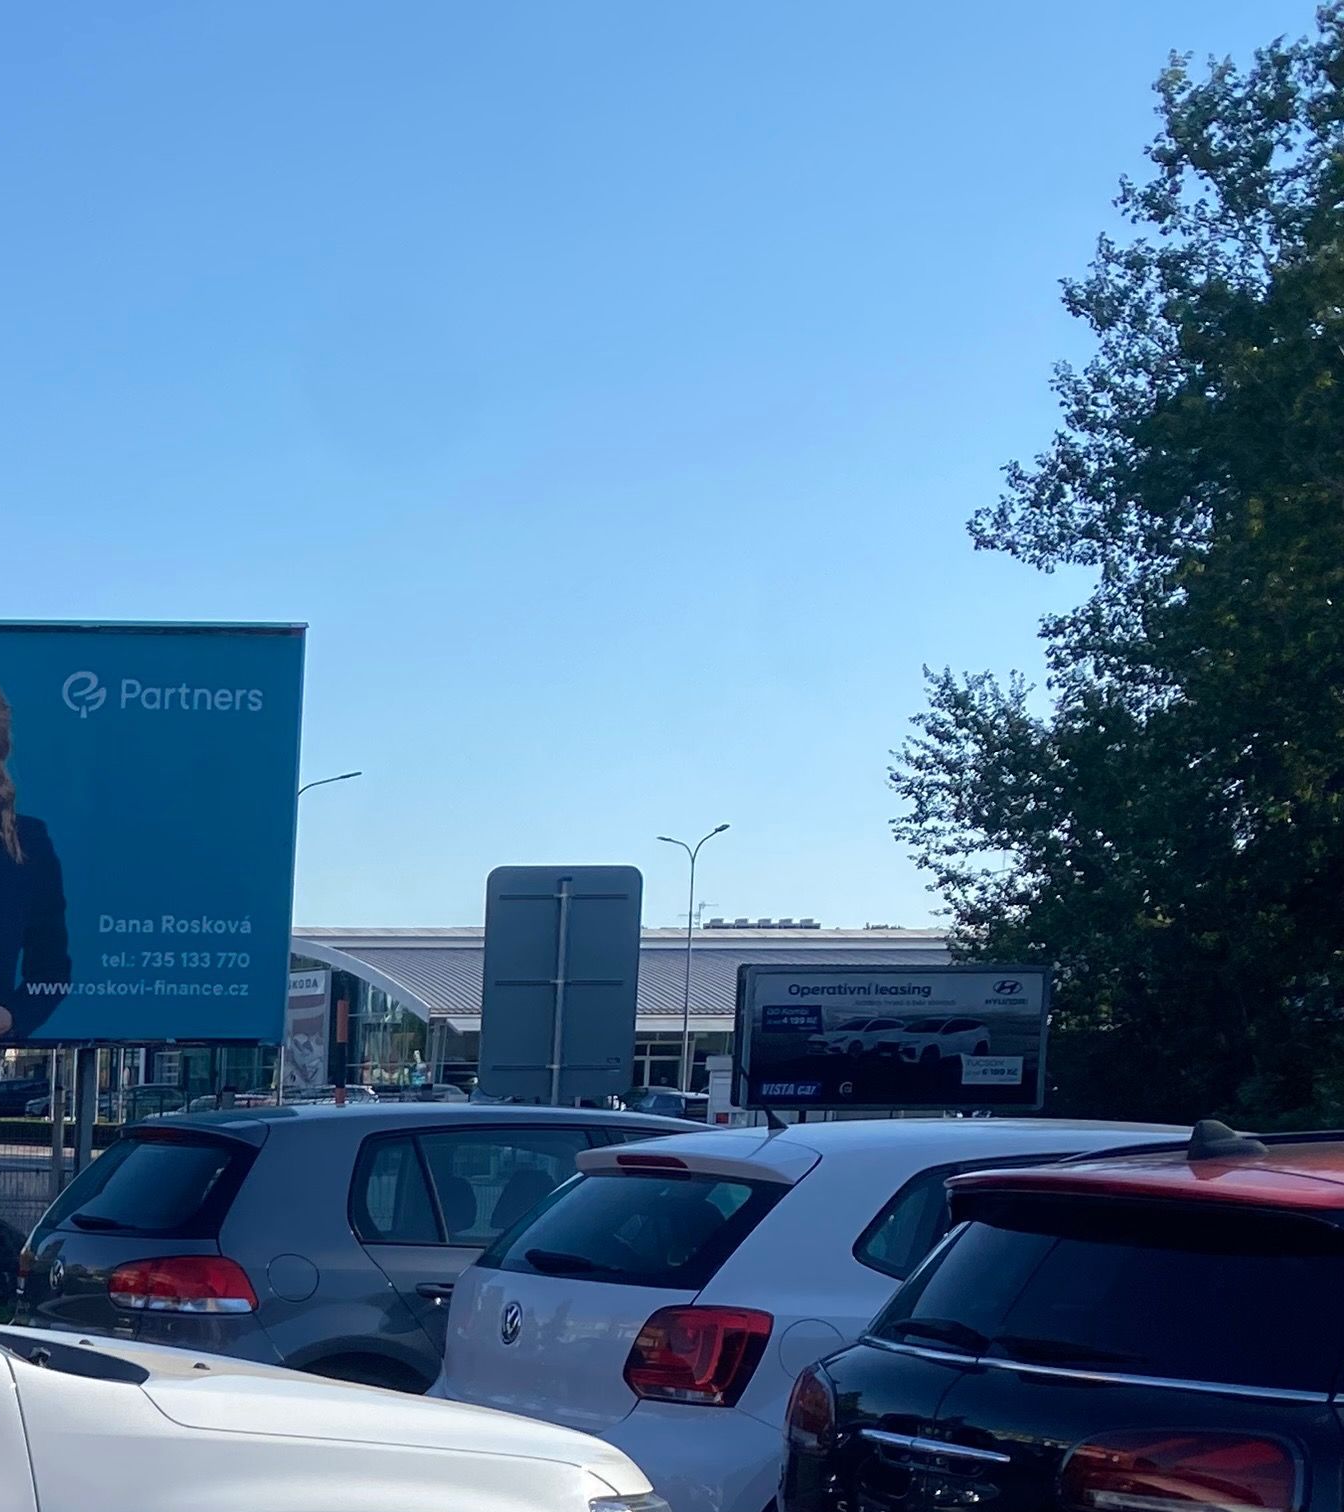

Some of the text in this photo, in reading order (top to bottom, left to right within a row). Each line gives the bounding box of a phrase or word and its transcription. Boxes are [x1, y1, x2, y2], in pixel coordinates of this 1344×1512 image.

[120, 678, 263, 711] Partners
[99, 914, 252, 934] Dana Rosková
[101, 952, 251, 968] tel.: 735 133 770
[26, 979, 249, 996] www.roskovi-finance.cz
[788, 982, 932, 998] Operativní leasing
[761, 1083, 795, 1096] VISTA
